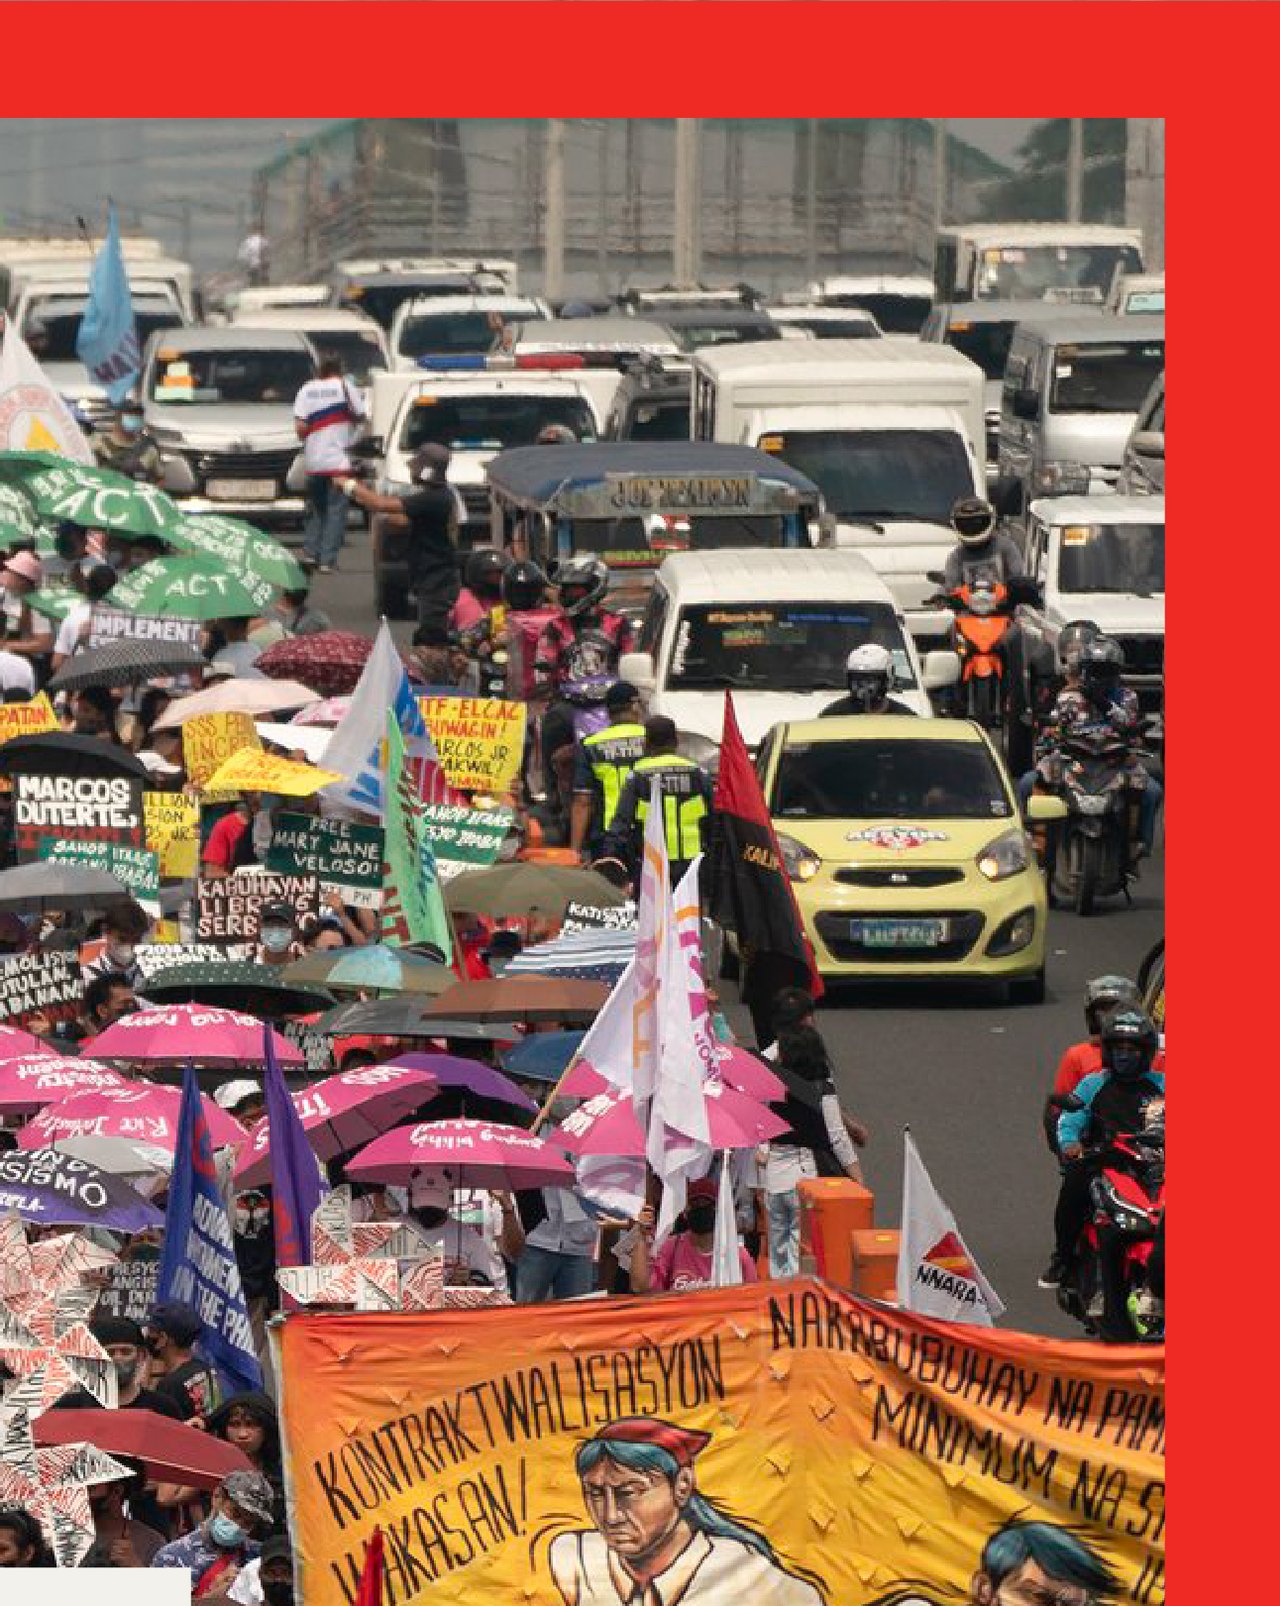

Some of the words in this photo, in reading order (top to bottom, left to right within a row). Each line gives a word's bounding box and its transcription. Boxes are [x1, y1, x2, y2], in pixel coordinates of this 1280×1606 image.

[16, 801, 137, 827] DUTERTE,
[19, 776, 130, 801] MARCOS
[314, 1335, 727, 1531] KONTRAKTWALISASYON
[1044, 1377, 1093, 1435] NA
[873, 1386, 1058, 1500] MINIMUM
[1070, 1460, 1127, 1530] NA
